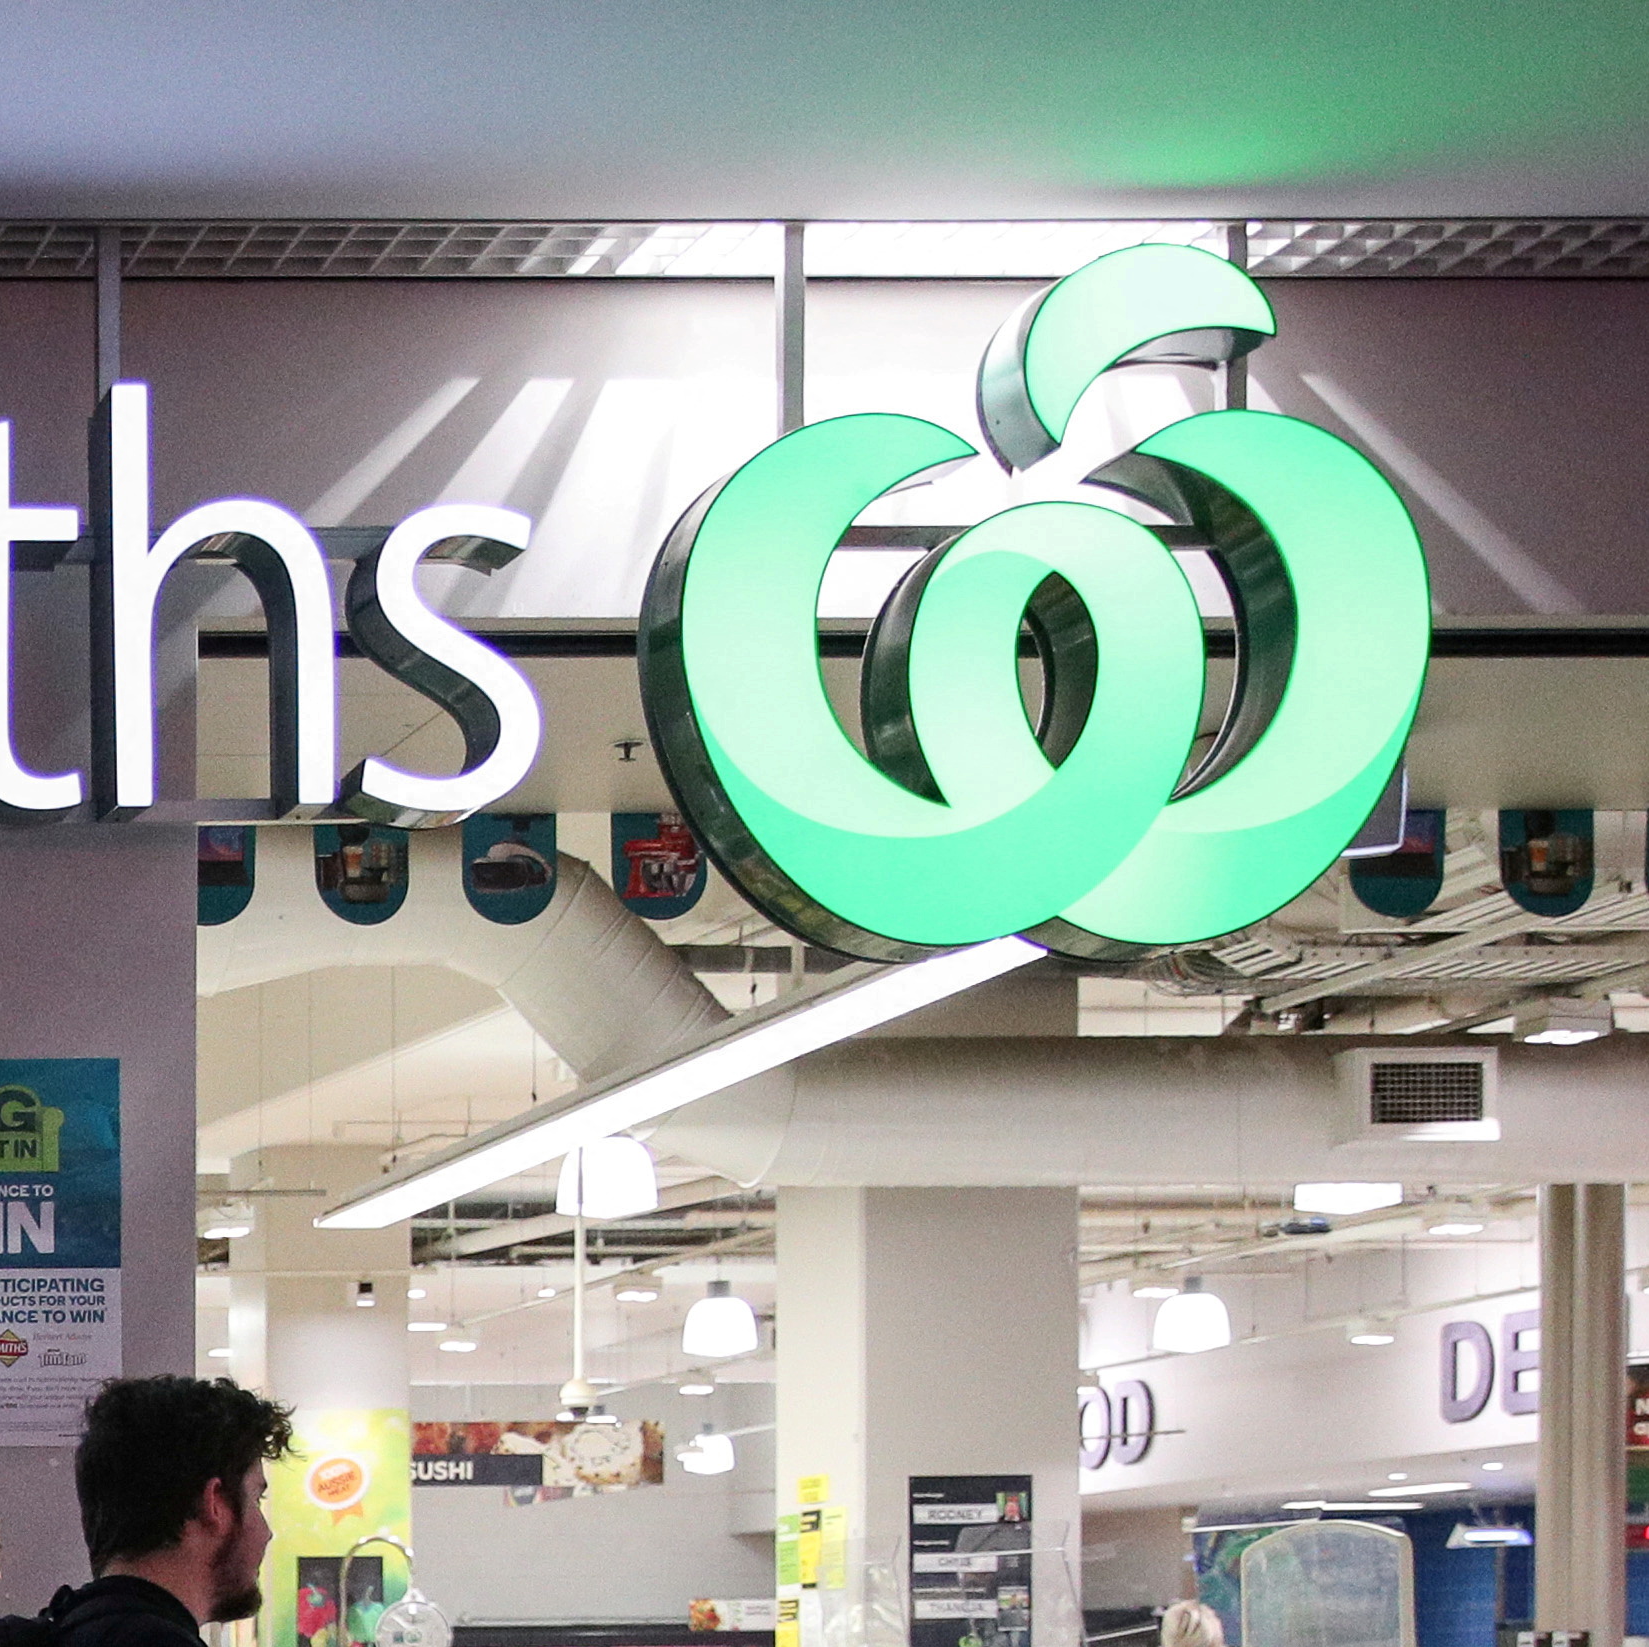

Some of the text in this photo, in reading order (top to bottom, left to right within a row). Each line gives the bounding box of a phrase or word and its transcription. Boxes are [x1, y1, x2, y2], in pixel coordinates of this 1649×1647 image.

[14, 1140, 37, 1158] IN
[33, 1185, 54, 1197] TO
[39, 1296, 66, 1306] FOR
[69, 1295, 106, 1305] YOUR
[42, 1310, 66, 1324] TO
[411, 1460, 474, 1481] SUSHI
